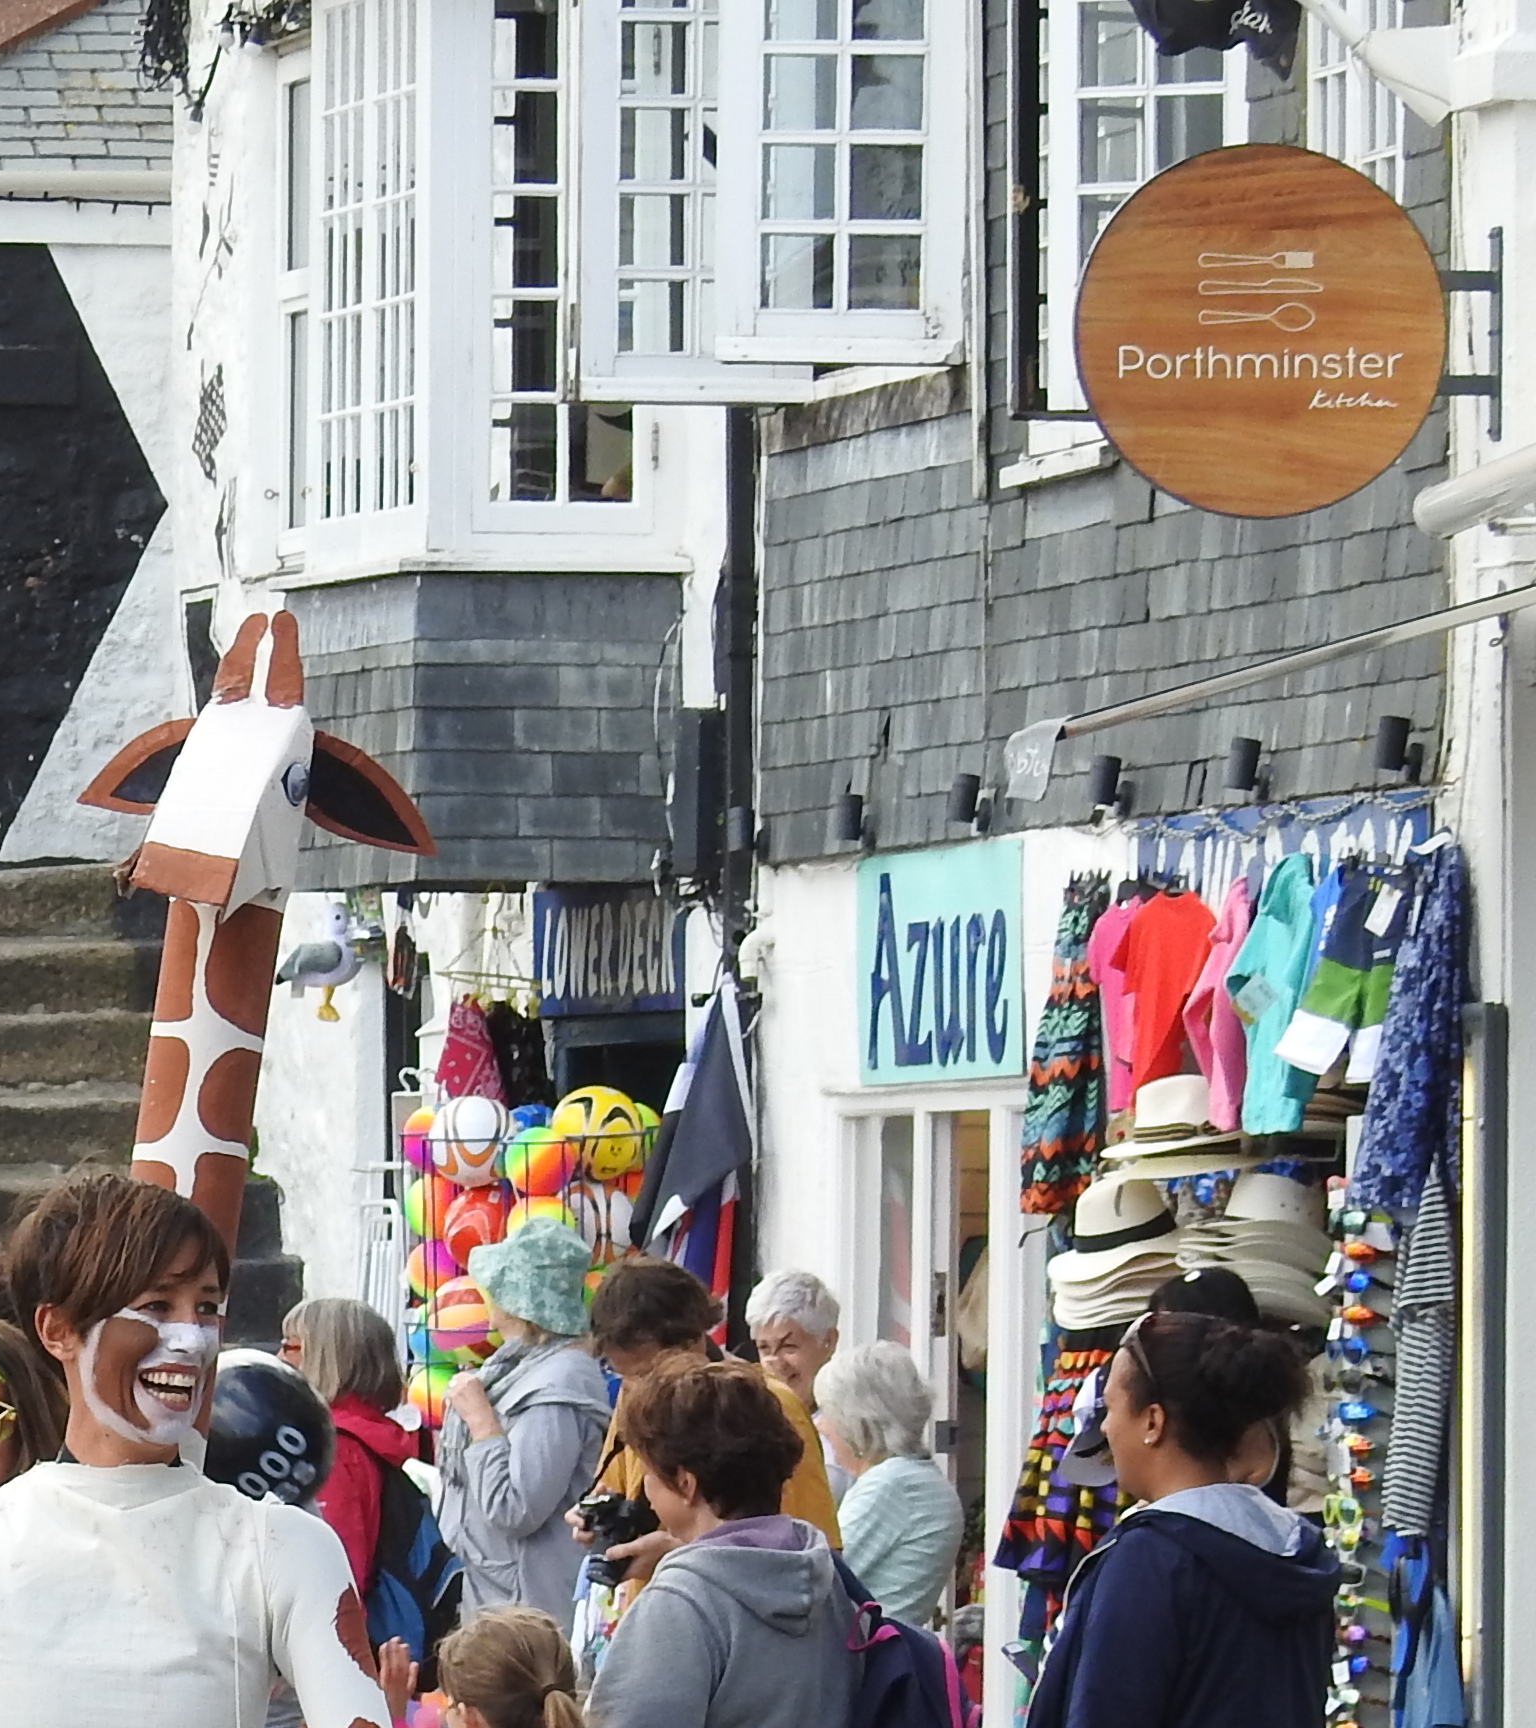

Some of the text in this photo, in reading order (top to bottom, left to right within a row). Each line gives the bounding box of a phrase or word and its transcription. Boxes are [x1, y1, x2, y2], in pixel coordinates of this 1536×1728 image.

[1117, 344, 1404, 380] Porthminster
[541, 899, 676, 1000] LOWER DECK
[867, 872, 1009, 1071] Azure
[237, 1424, 308, 1498] 000
